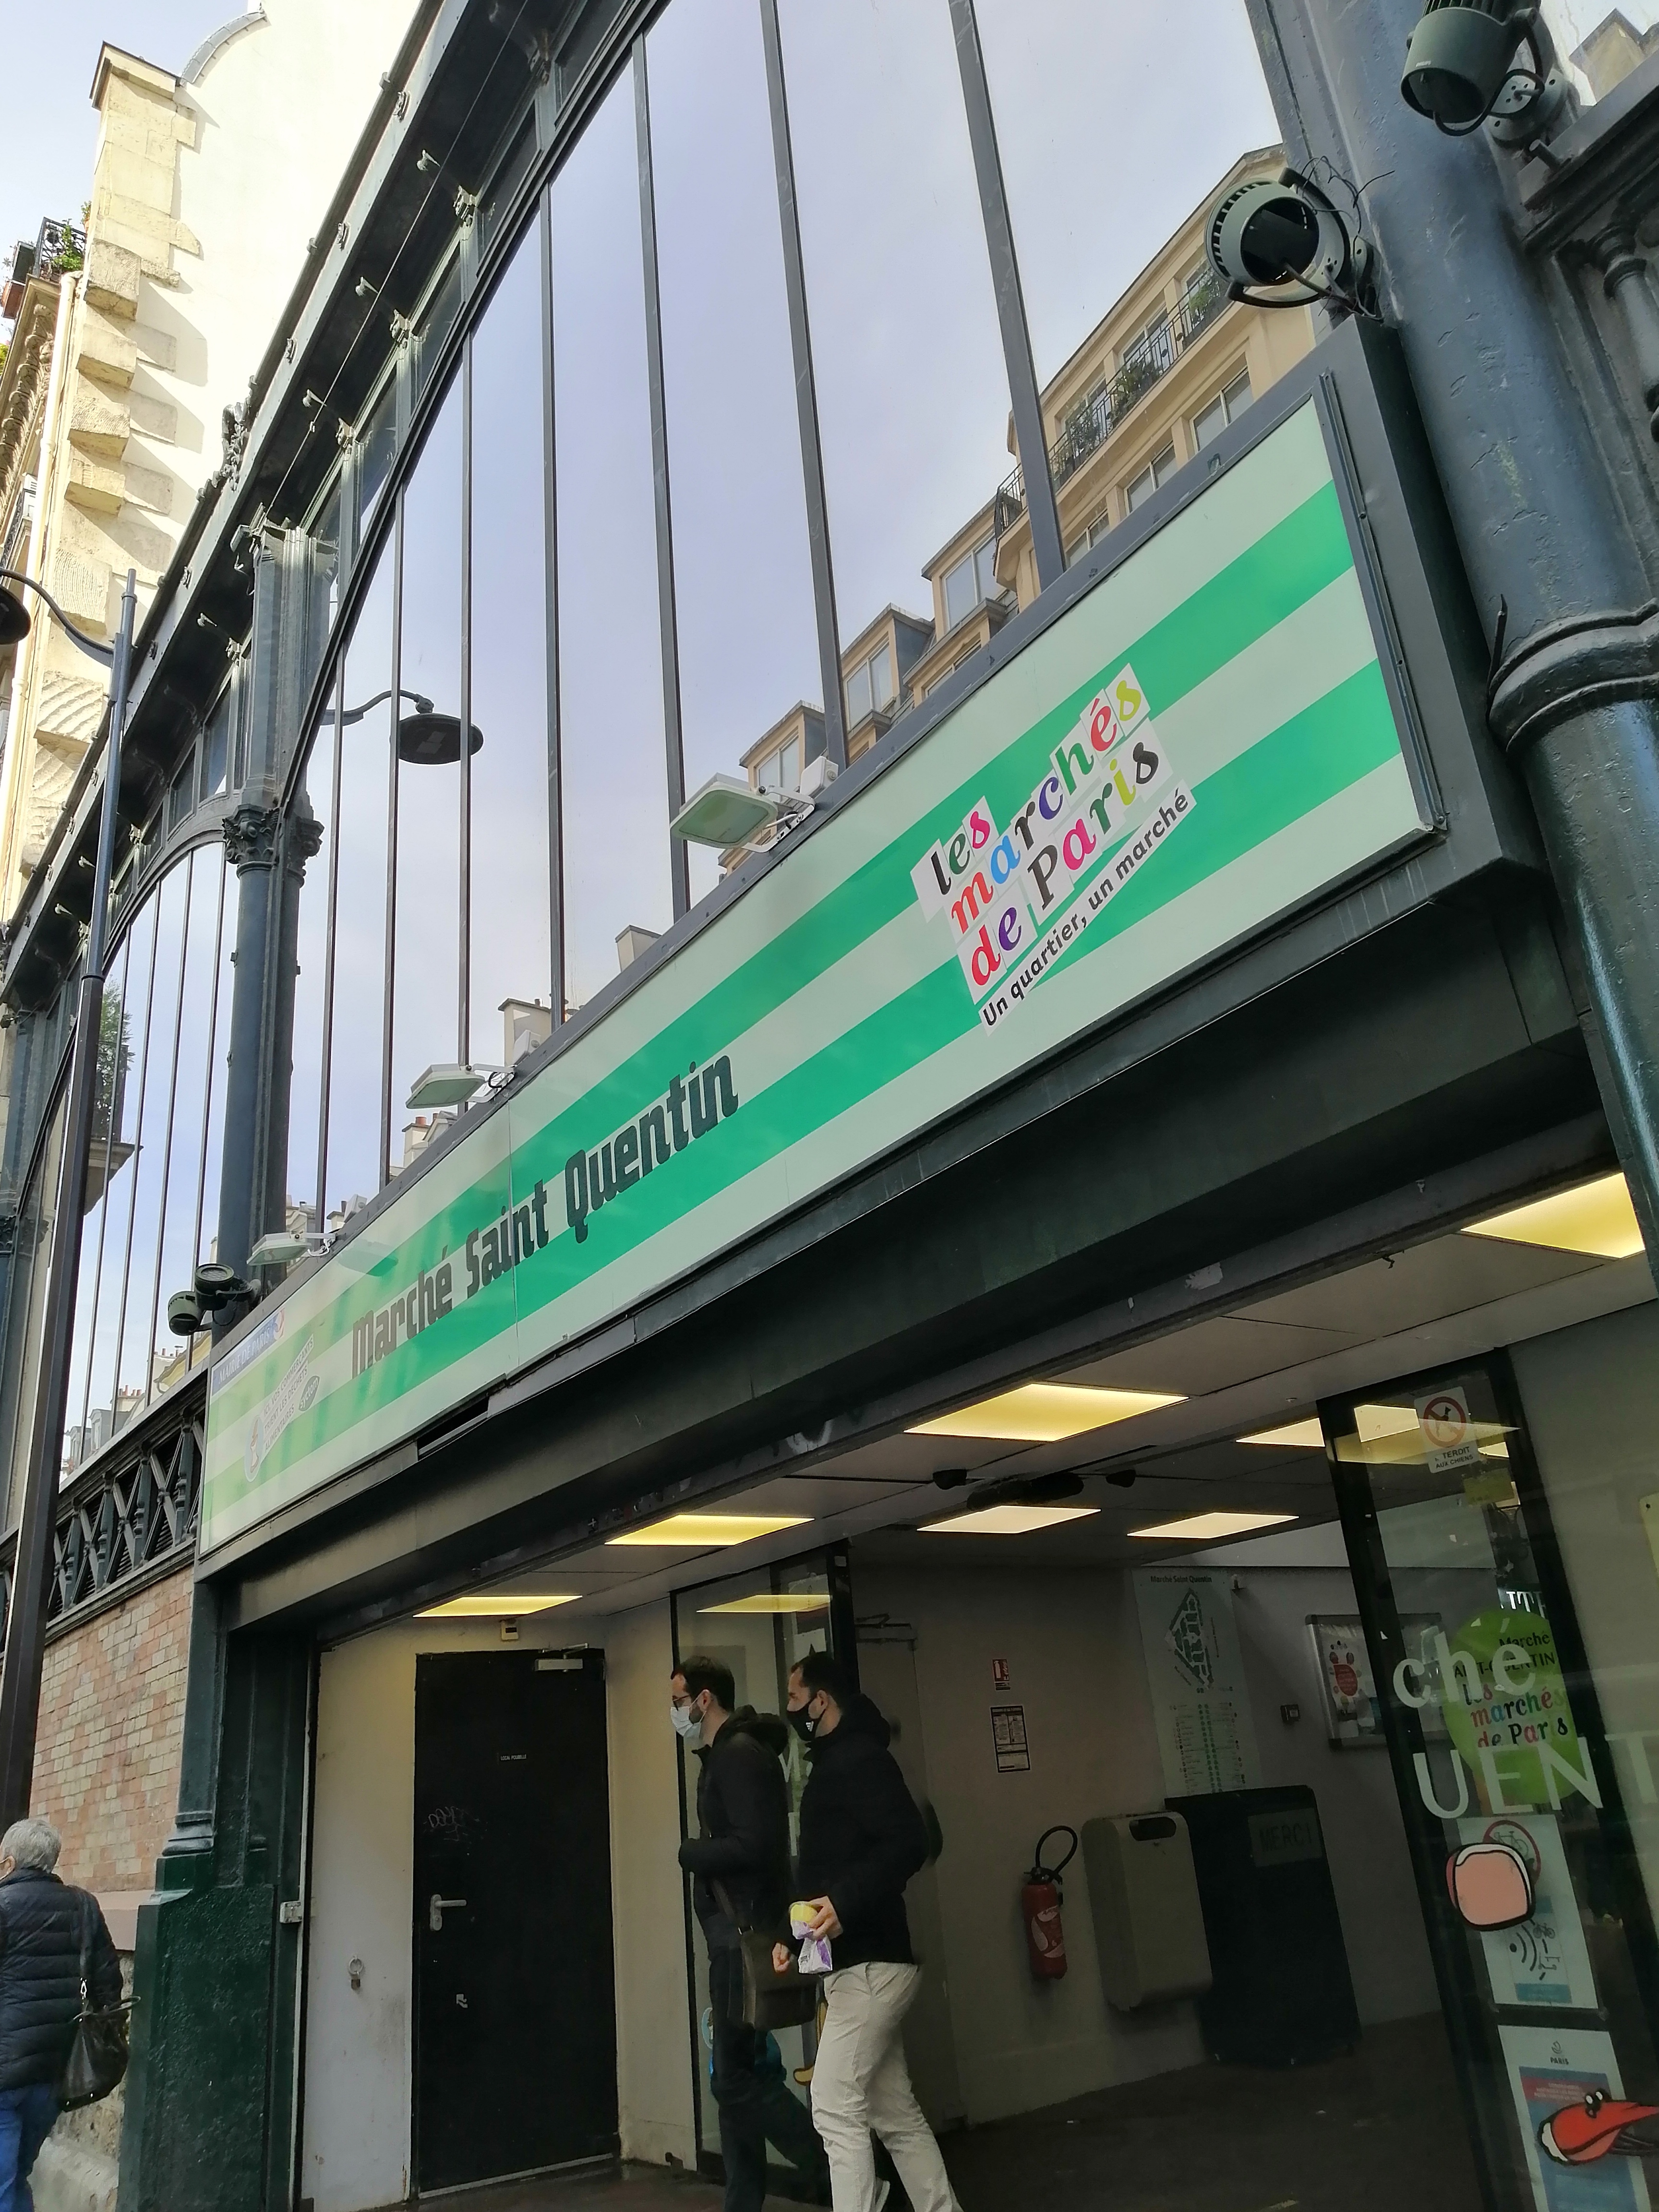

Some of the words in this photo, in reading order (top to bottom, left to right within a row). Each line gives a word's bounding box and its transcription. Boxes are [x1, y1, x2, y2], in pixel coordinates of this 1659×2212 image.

[951, 680, 1142, 934] marchés
[931, 811, 990, 895] les
[972, 907, 1022, 986] de
[1027, 742, 1159, 911] Paris
[983, 997, 1009, 1026] Un
[1011, 914, 1087, 1000] quartier,
[1088, 878, 1114, 910] un
[1115, 787, 1189, 881] marché
[352, 1245, 453, 1380] Marché
[466, 1179, 549, 1299] Saint
[565, 1055, 739, 1244] Quentin
[219, 1355, 240, 1384] MAIRIE
[241, 1345, 251, 1365] DE
[252, 1327, 270, 1356] PARIS
[264, 1408, 279, 1434] TRIENT
[279, 1396, 288, 1413] LES
[271, 1390, 280, 1405] VOS
[300, 1377, 319, 1409] syctom
[264, 1403, 295, 1453] ALIMENTAIRES
[1450, 1455, 1474, 1465] CHIENS
[1478, 1731, 1502, 1748] de
[1259, 1823, 1312, 1852] MERCI
[1550, 2057, 1569, 2065] PARIS
